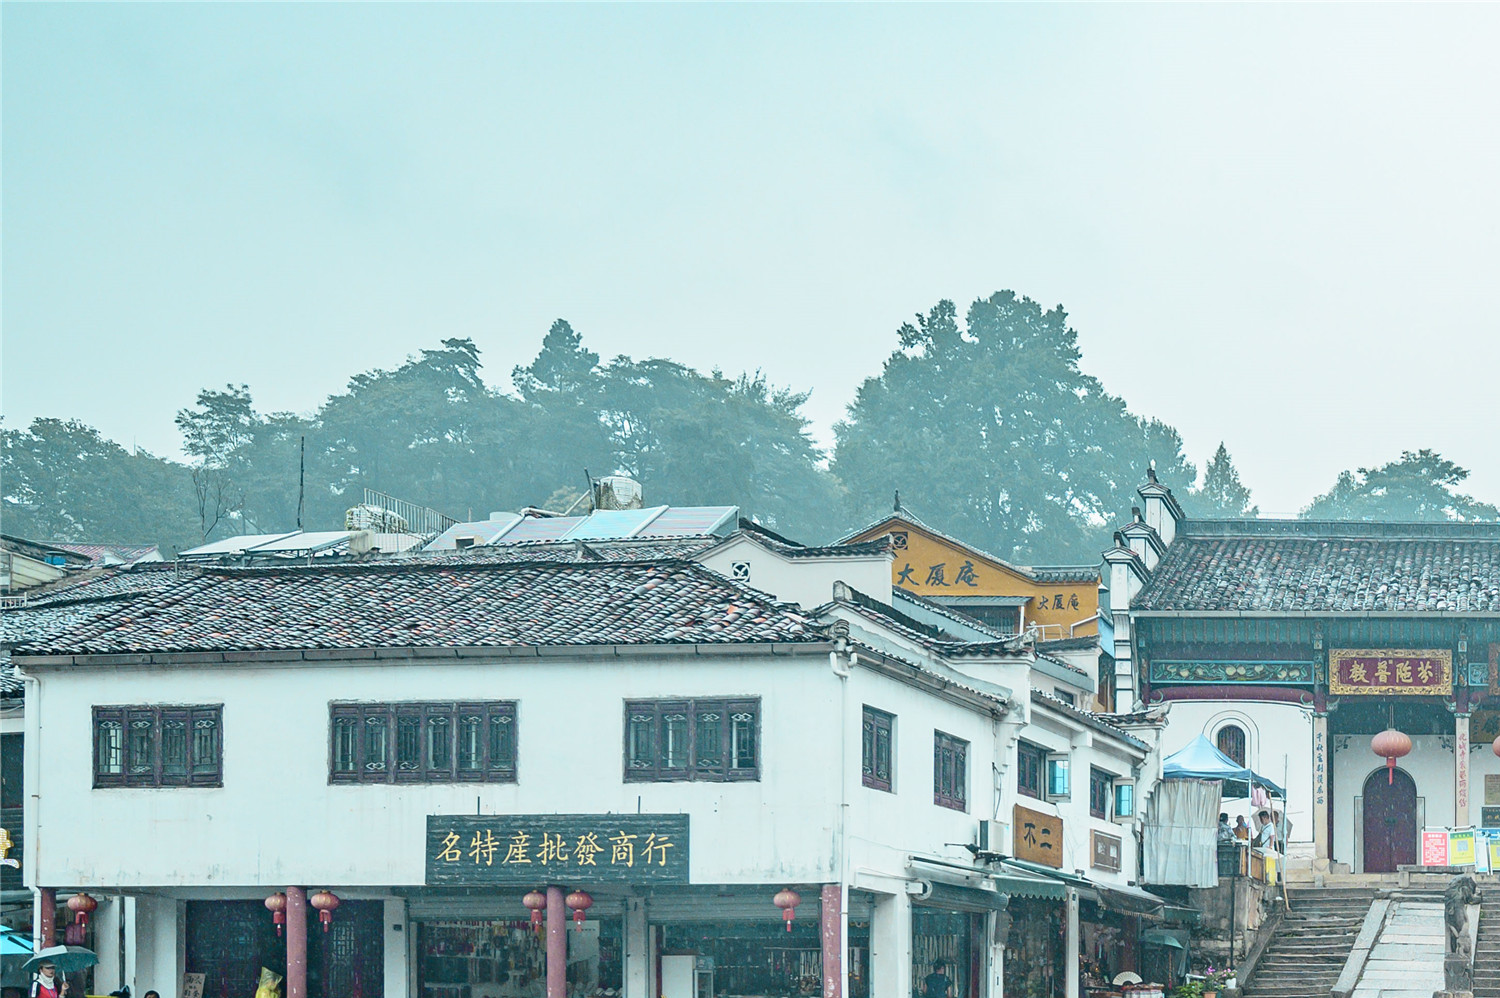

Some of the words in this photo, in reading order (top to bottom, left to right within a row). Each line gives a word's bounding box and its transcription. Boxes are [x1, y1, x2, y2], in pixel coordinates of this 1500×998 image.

[435, 829, 675, 868] 名特産批發商行
[1023, 822, 1053, 849] 不二
